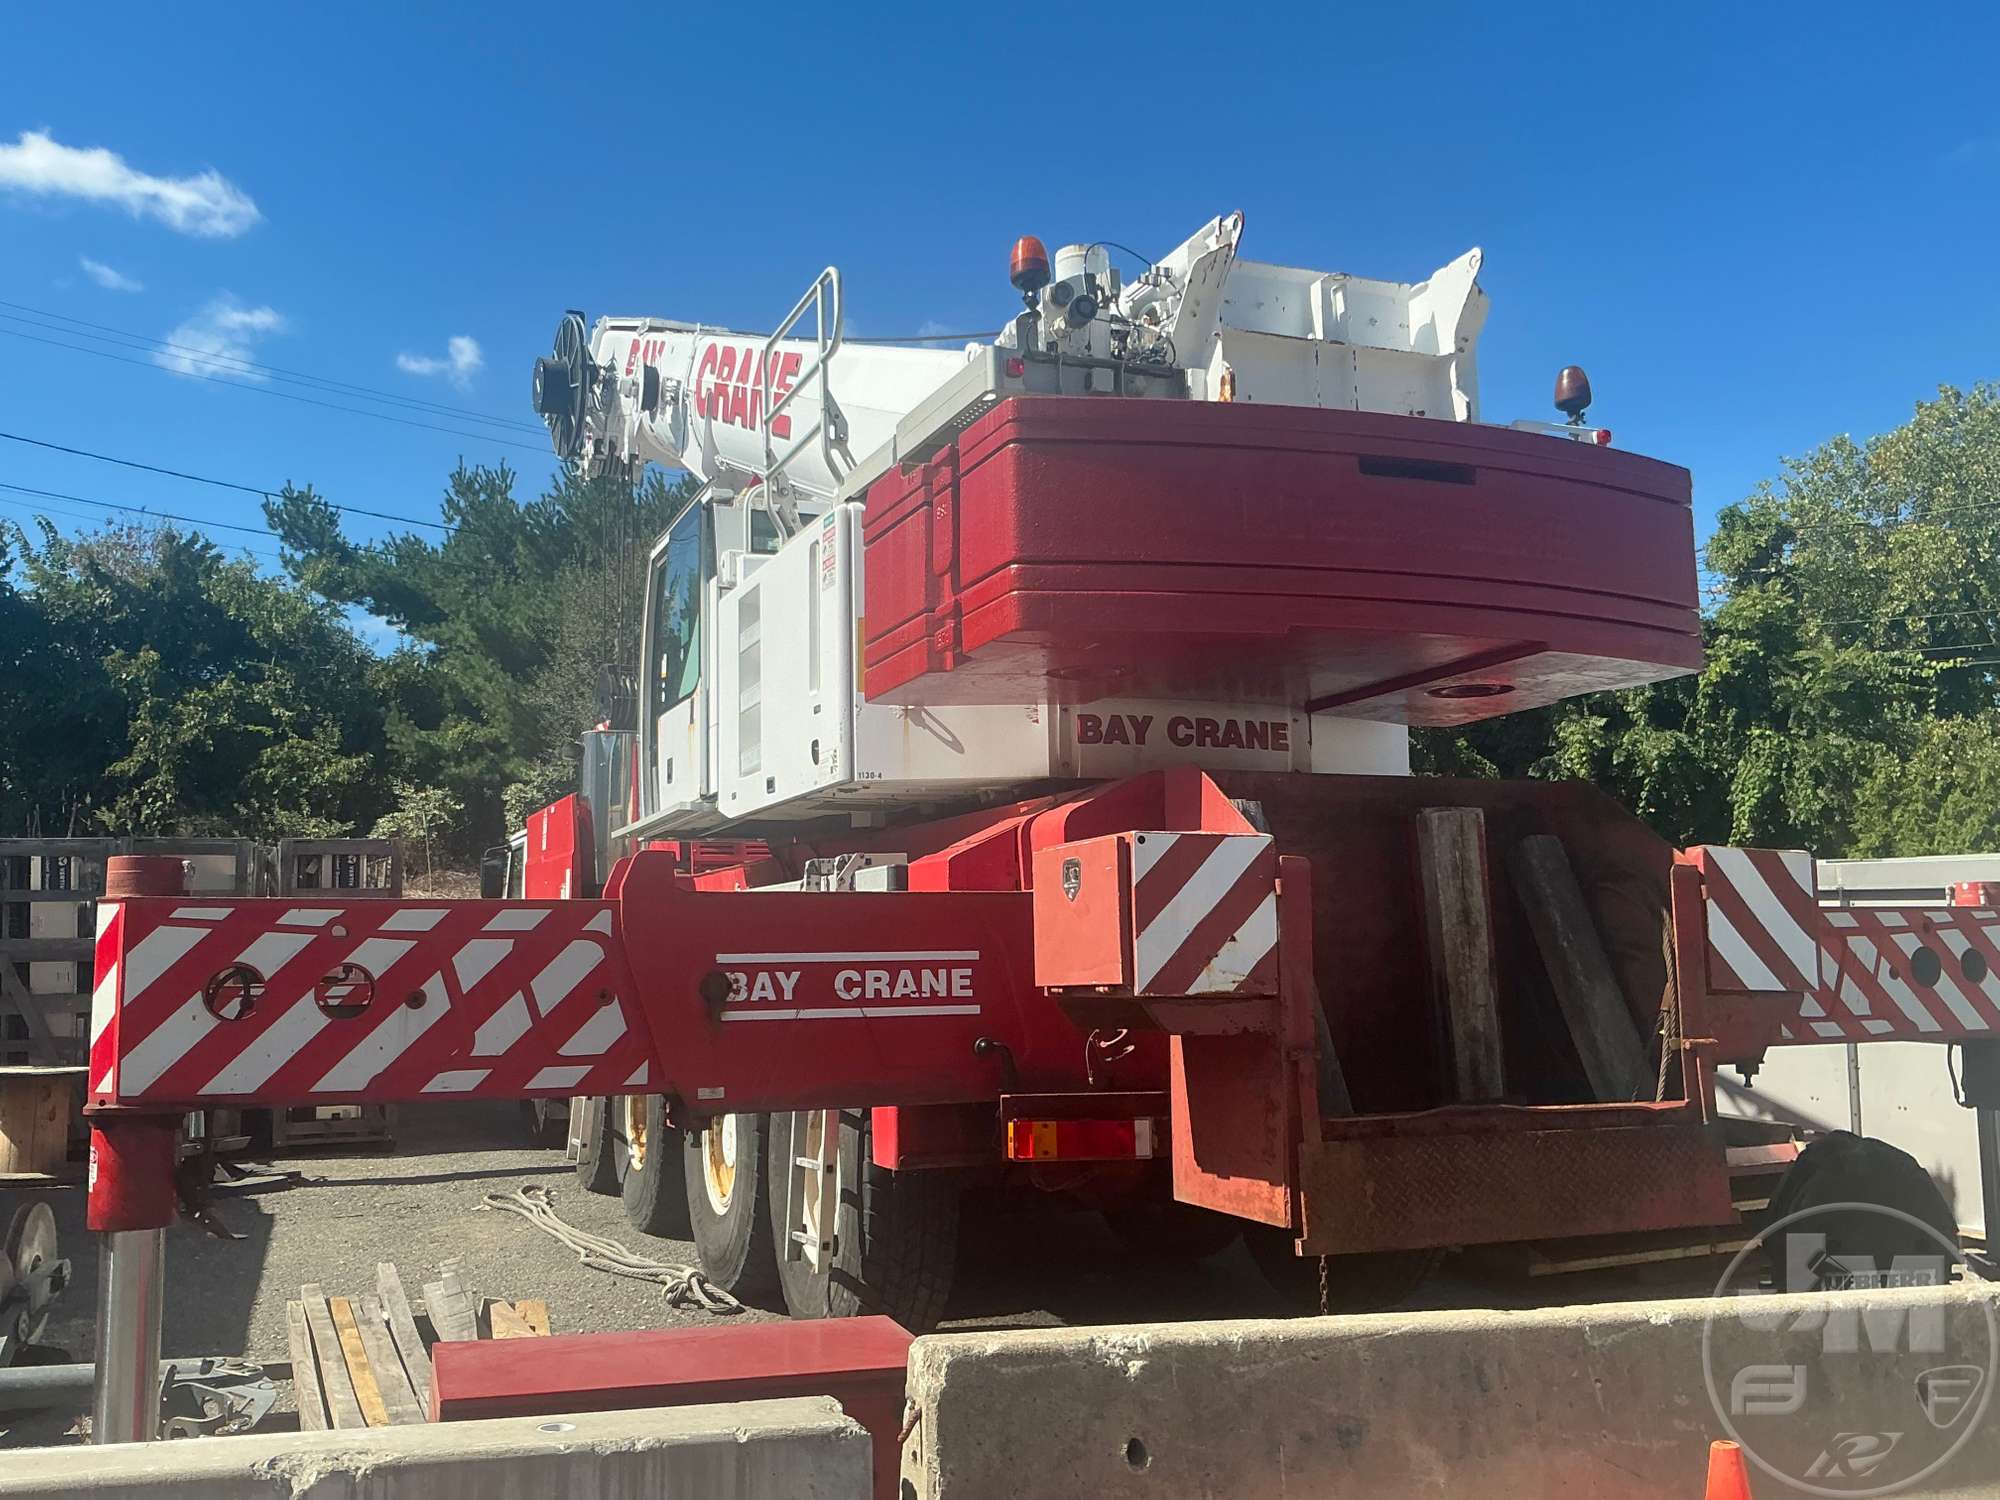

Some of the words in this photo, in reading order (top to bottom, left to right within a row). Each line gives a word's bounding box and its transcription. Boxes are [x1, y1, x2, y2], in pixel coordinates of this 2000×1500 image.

[696, 342, 803, 441] CRANE
[1077, 714, 1153, 745] BAY
[1167, 716, 1289, 752] CRANE
[724, 971, 800, 1002] BAY
[834, 968, 974, 1000] CRANE
